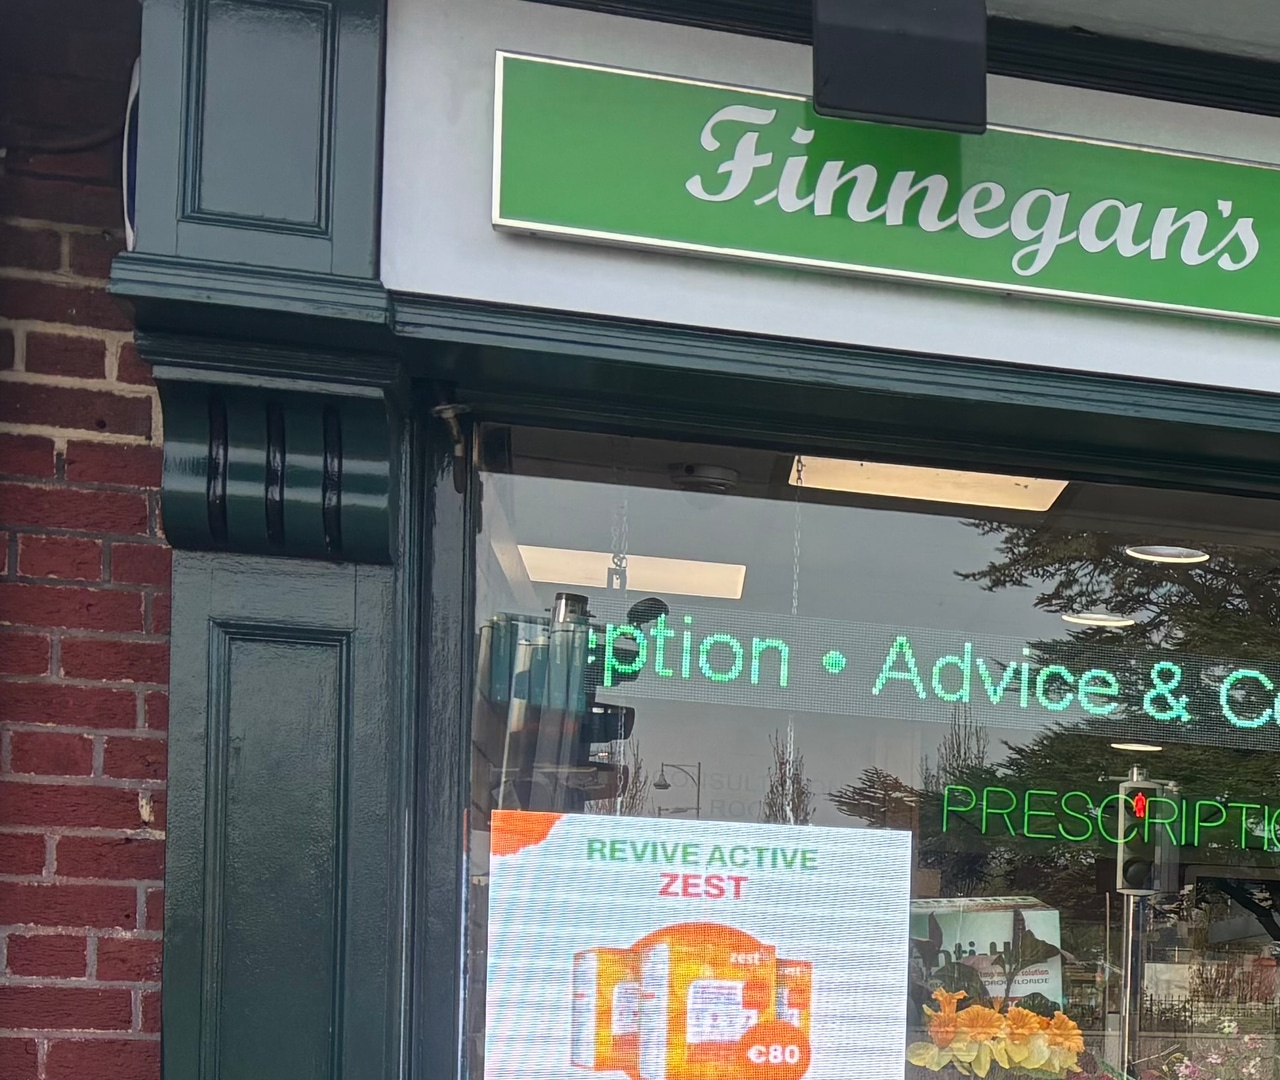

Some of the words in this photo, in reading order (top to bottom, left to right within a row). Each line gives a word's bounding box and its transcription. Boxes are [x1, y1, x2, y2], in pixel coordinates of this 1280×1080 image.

[685, 105, 1260, 276] Finnegan's
[872, 634, 1121, 714] Advice
[1143, 660, 1192, 722] &
[586, 838, 700, 866] REVIVE
[705, 843, 819, 871] ACTIVE
[658, 872, 750, 900] ZEST
[747, 1044, 801, 1066] €80
